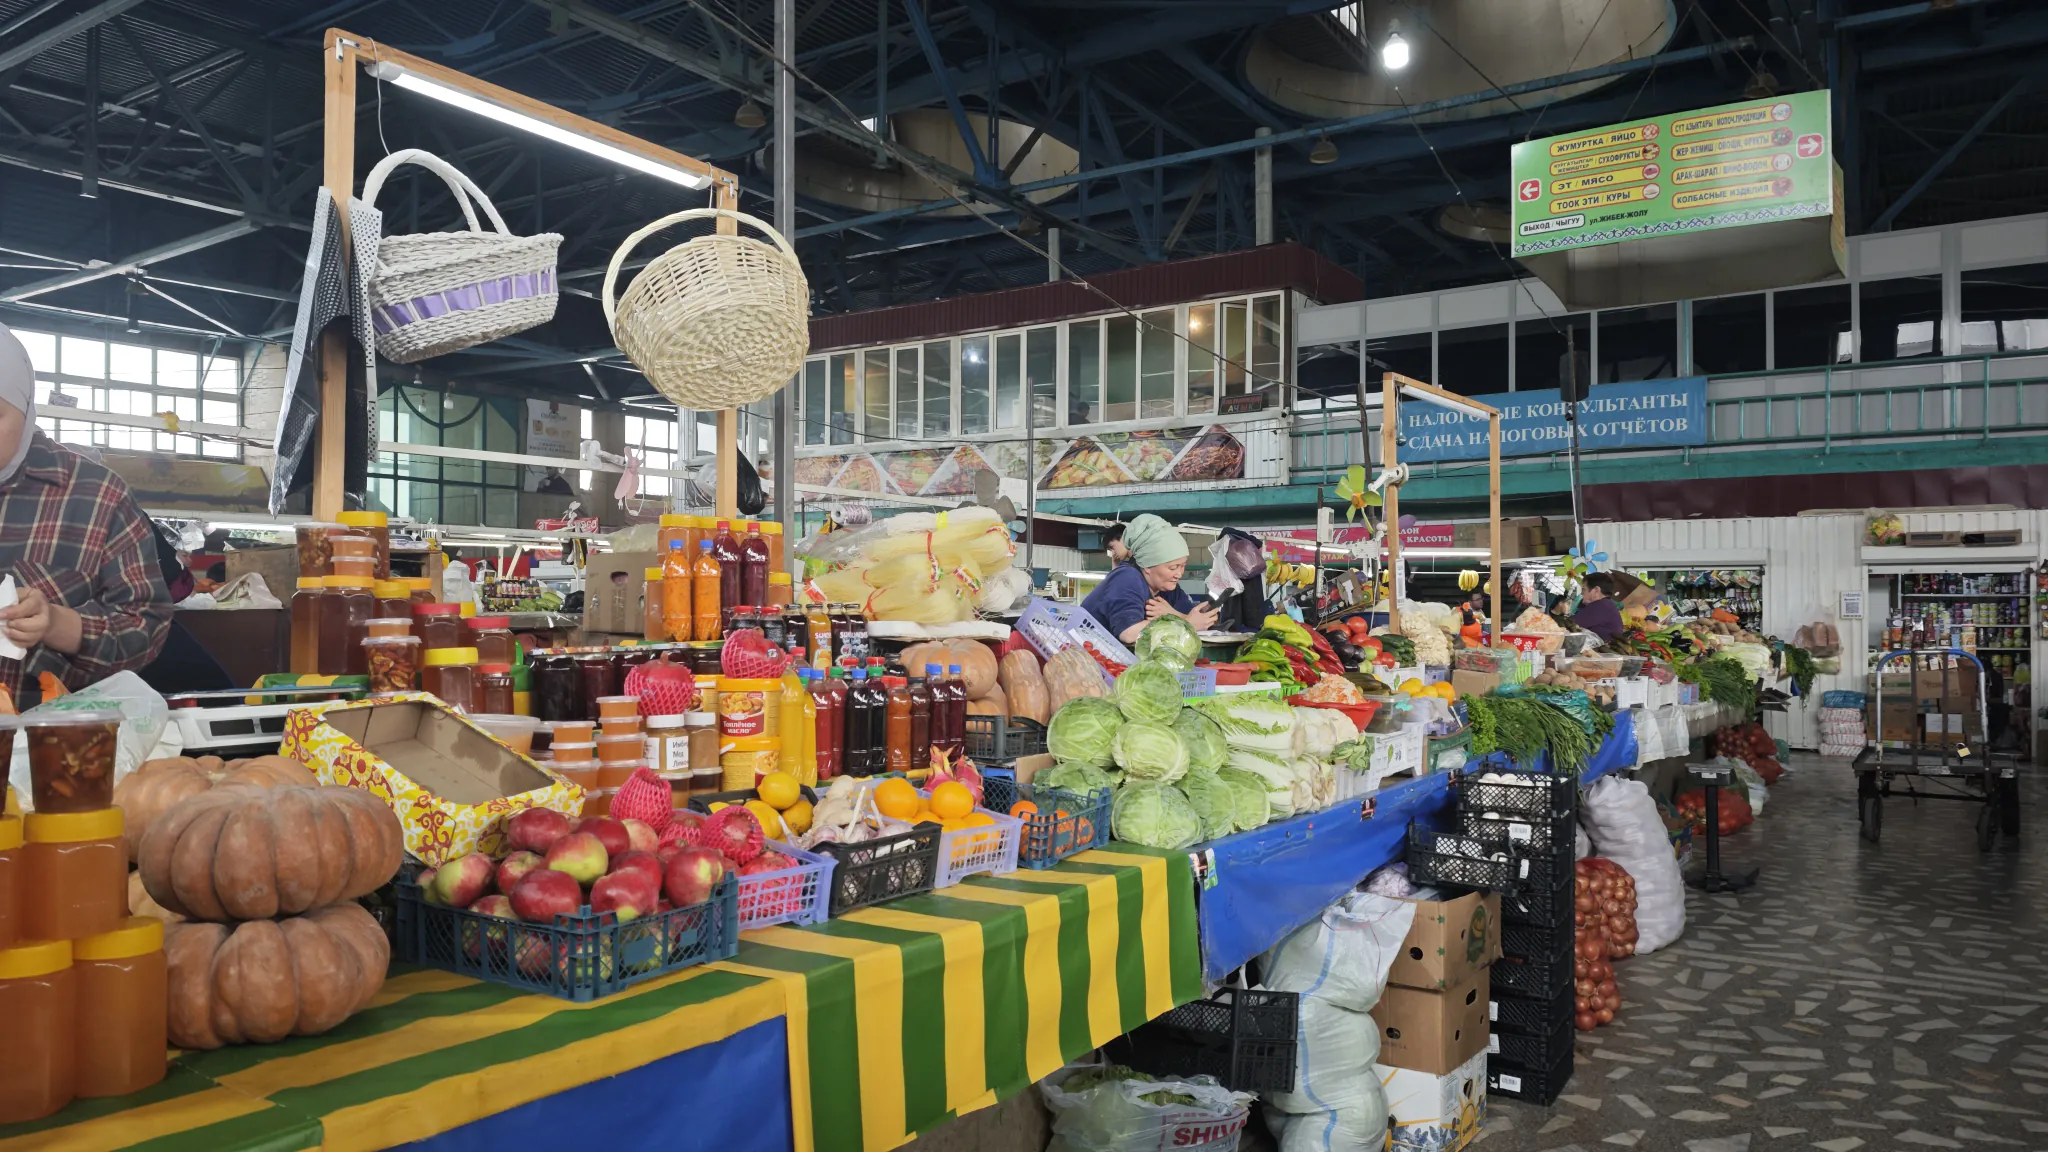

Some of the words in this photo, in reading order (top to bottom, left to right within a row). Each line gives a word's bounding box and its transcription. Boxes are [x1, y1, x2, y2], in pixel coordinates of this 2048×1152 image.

[1686, 118, 1713, 132] АЗЫКТАРЫ
[1557, 138, 1604, 152] ЖУМУРТКА
[1611, 131, 1636, 143] ЯЙЦО
[1598, 150, 1641, 165] СУХОФРУКТЫ
[1676, 146, 1689, 157] ЖЕР
[1690, 143, 1714, 154] ЖЕМИШ
[1675, 166, 1719, 181] АРАК-ШАРАП
[1558, 181, 1573, 190] ЭТ
[1581, 175, 1614, 187] МЯСО
[1557, 200, 1579, 210] ТООК
[1582, 196, 1600, 206] ЭТИ
[1606, 191, 1631, 202] КУРЫ
[1677, 190, 1727, 204] КОЛБАСНЫЕ
[1729, 184, 1769, 198] ИЗДЕЛИЯ
[1523, 222, 1550, 232] ВЫХОД
[1555, 216, 1580, 227] ЧЫГУУ
[1408, 432, 1464, 451] СДАЧА
[1593, 417, 1688, 436] ОТЧЁТОВ
[1406, 535, 1452, 543] КРАСОТЫ
[1321, 552, 1345, 561] ЭТАЖ
